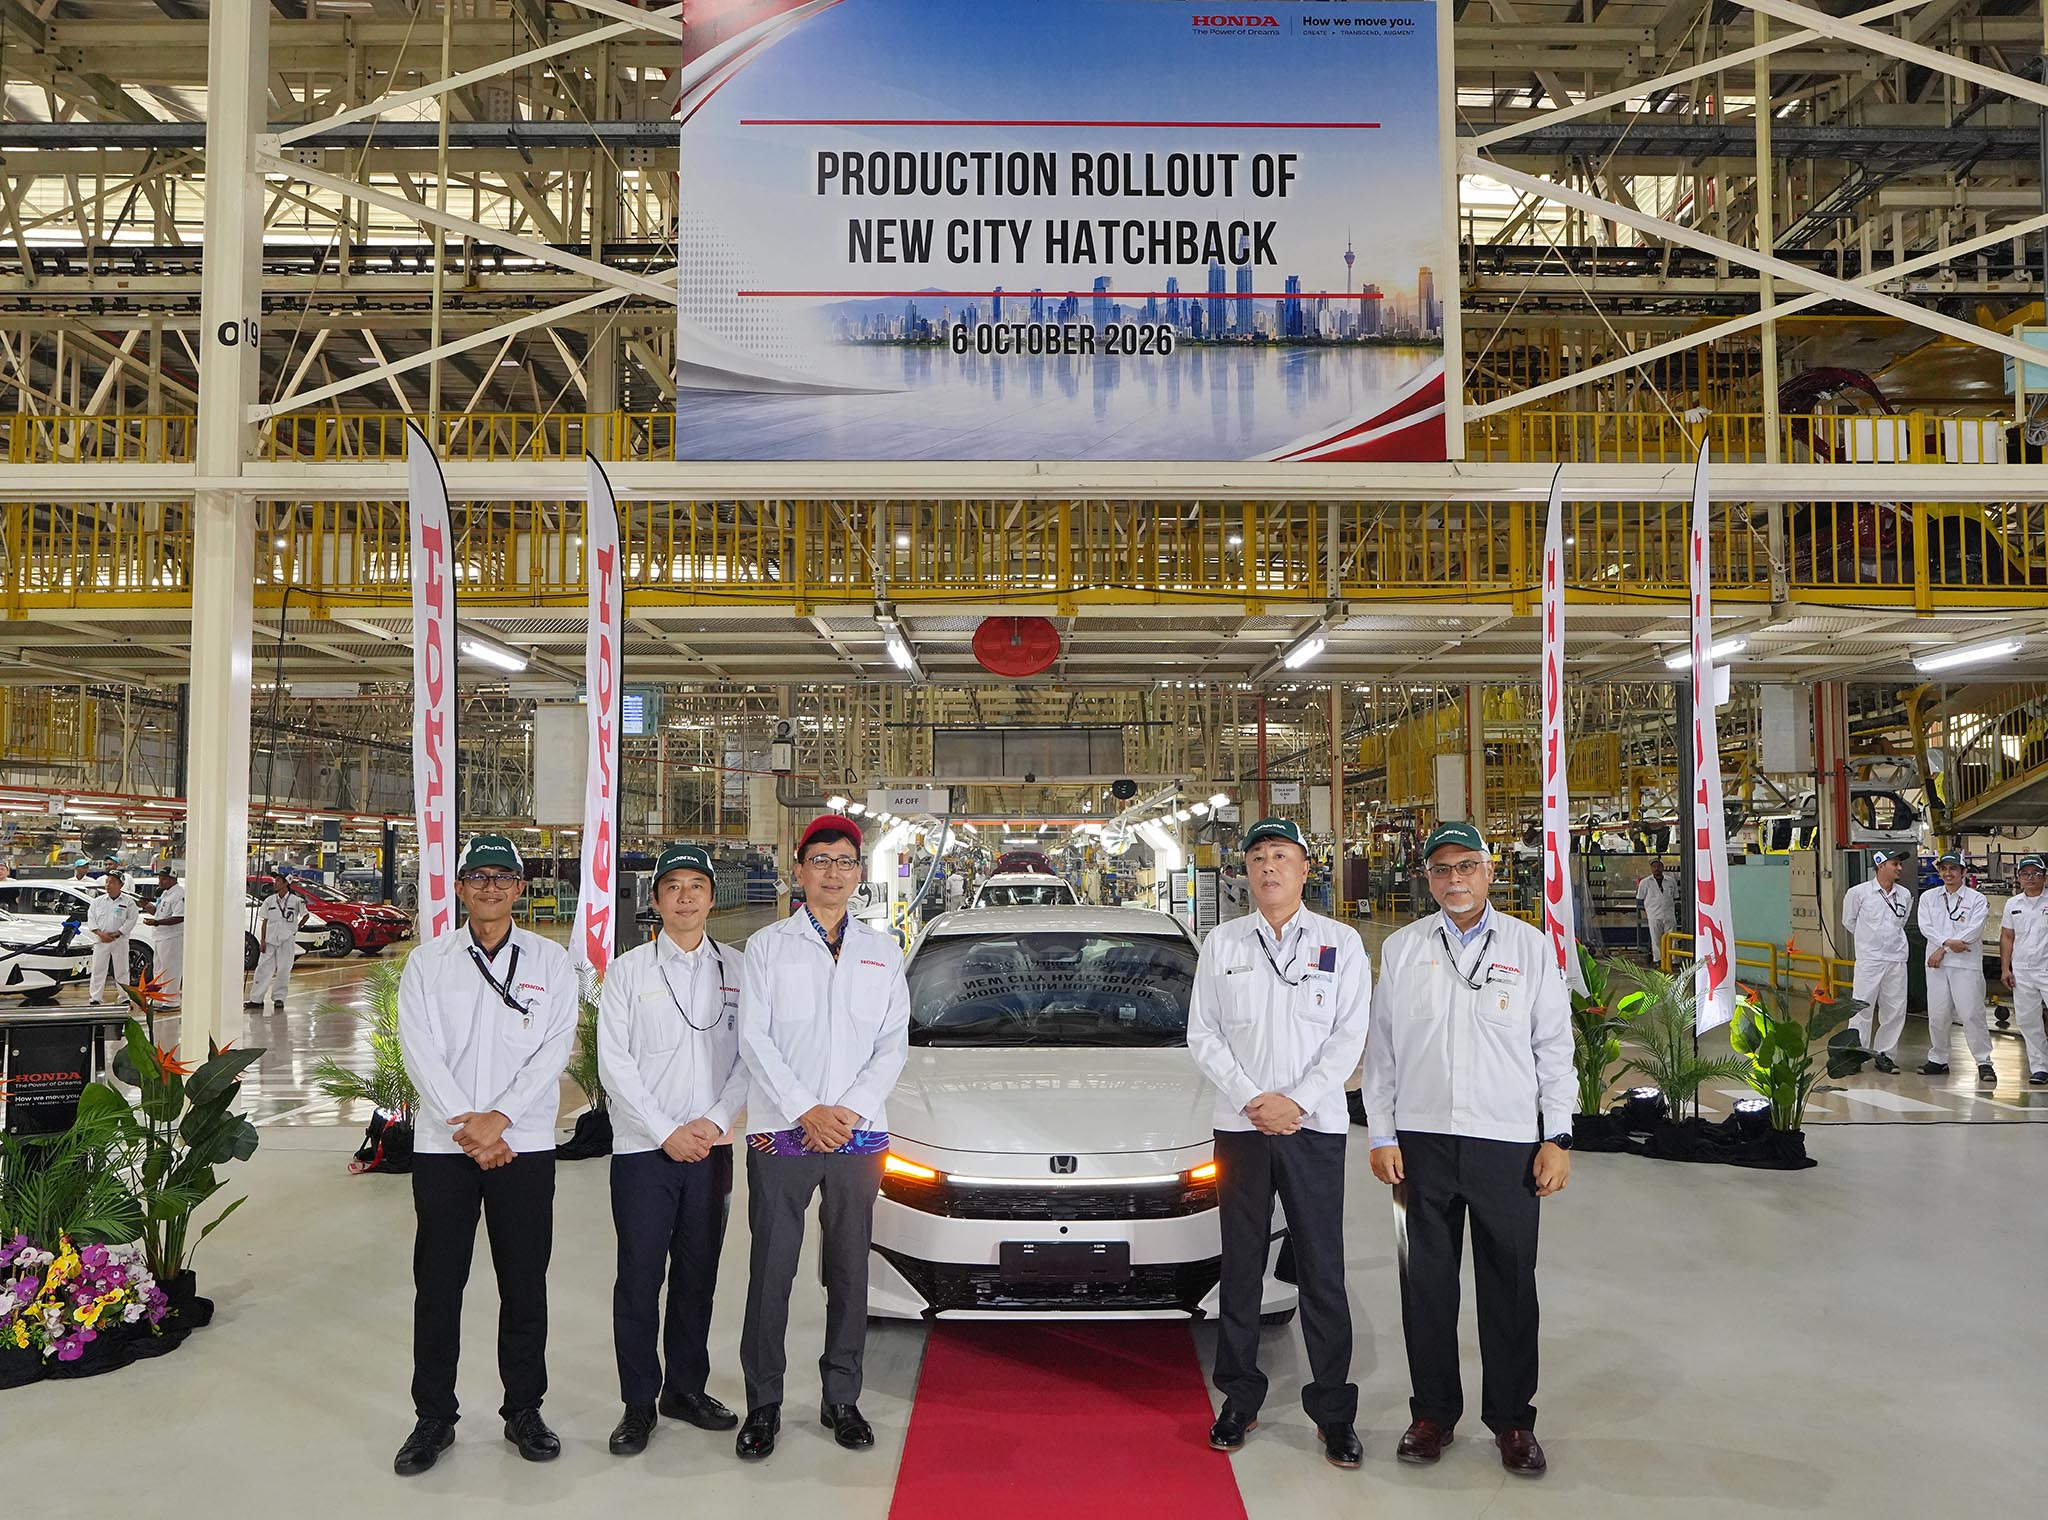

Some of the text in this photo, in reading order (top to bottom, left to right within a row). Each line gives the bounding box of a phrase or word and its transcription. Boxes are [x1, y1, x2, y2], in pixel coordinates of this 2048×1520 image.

[1192, 15, 1280, 27] HONDA
[1303, 16, 1415, 28] How we move you.
[817, 151, 1298, 198] PRODUCTION ROLLOUT OF
[848, 218, 1278, 265] NEW CITY HATCHBACK
[952, 323, 1173, 355] 6 OCTOBER 2026
[475, 844, 508, 852] HONDA
[666, 855, 699, 864] HONDA
[860, 959, 886, 968] HONDA
[1490, 962, 1520, 974] HONDA
[519, 982, 545, 992] HONDA
[15, 1072, 81, 1082] HONDA
[15, 1095, 32, 1103] How
